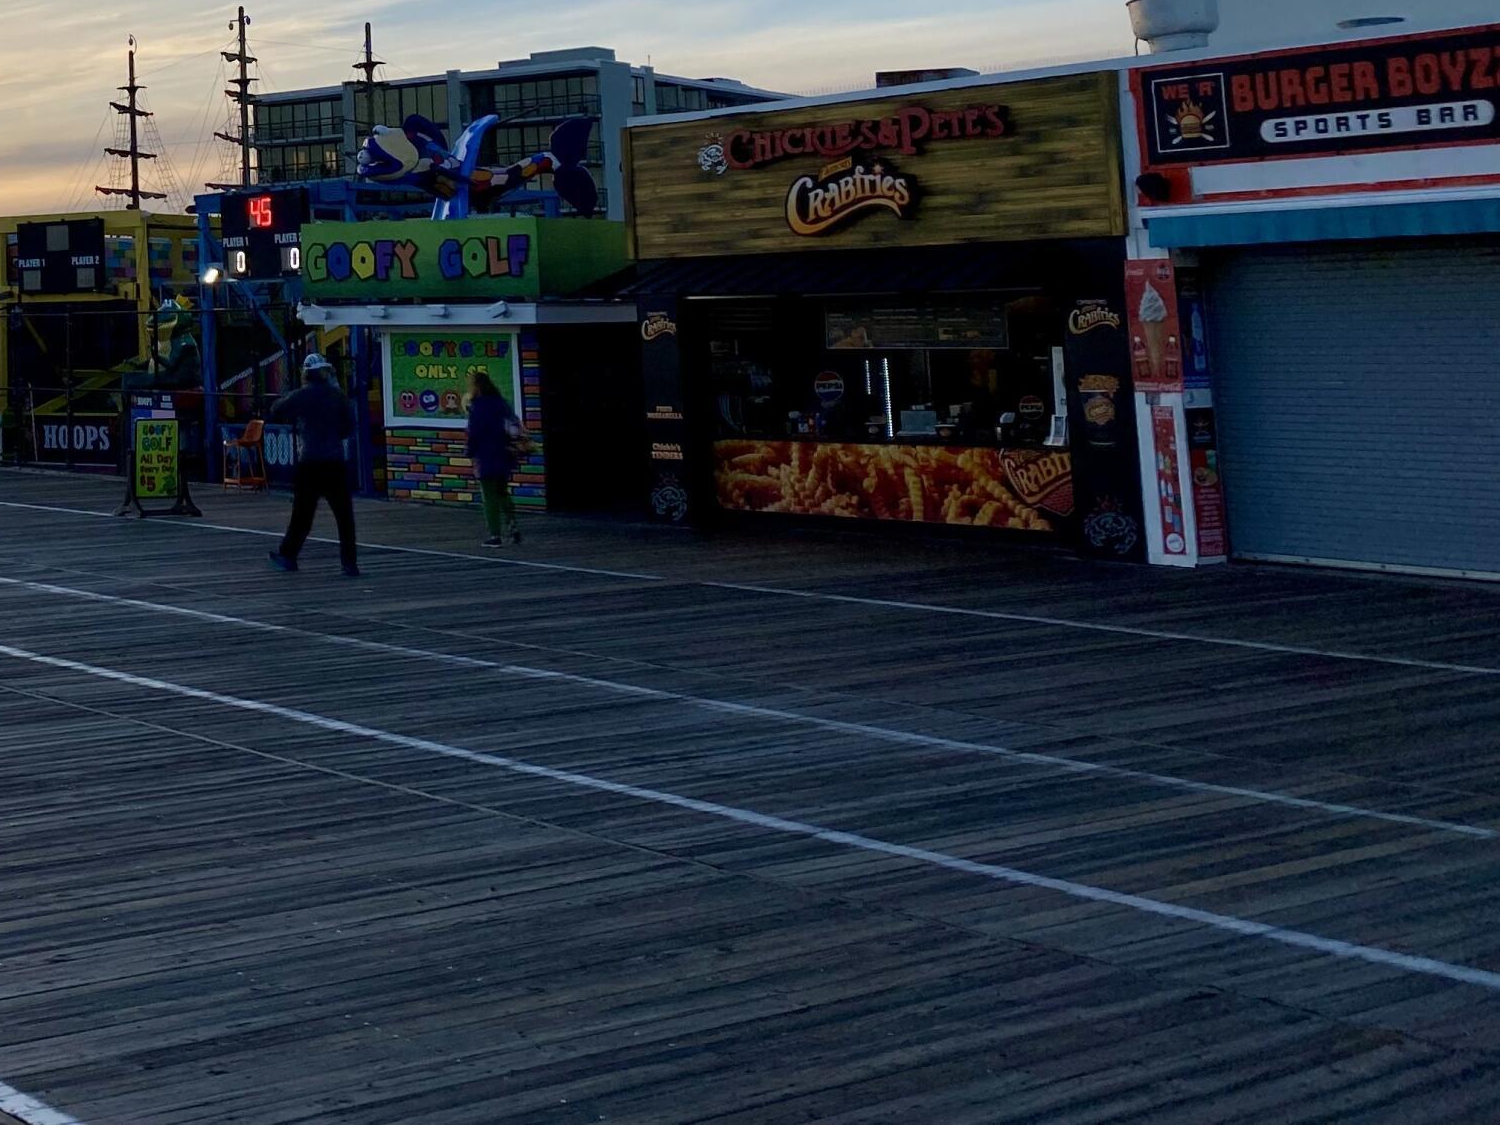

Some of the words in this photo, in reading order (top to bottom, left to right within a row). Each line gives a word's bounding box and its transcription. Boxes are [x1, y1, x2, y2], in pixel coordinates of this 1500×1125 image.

[1160, 83, 1190, 100] WE
[1230, 60, 1380, 113] BURGER
[1275, 112, 1391, 137] SPORTS
[1417, 104, 1478, 126] BAR
[250, 197, 272, 226] 45
[222, 236, 244, 248] PLAYER
[274, 232, 297, 244] PLAYER
[18, 258, 40, 268] PLAYER
[71, 256, 94, 265] PLAYER
[95, 255, 100, 264] 2
[236, 251, 246, 272] 0
[290, 247, 300, 269] 0
[306, 239, 419, 283] GOOFY
[438, 234, 529, 280] GOLF
[394, 340, 457, 357] GOOFY
[459, 340, 509, 358] GOLF
[414, 363, 459, 379] ONLY
[43, 424, 110, 450] HOOPS
[142, 424, 173, 435] GOOFY
[141, 436, 173, 452] GOLF
